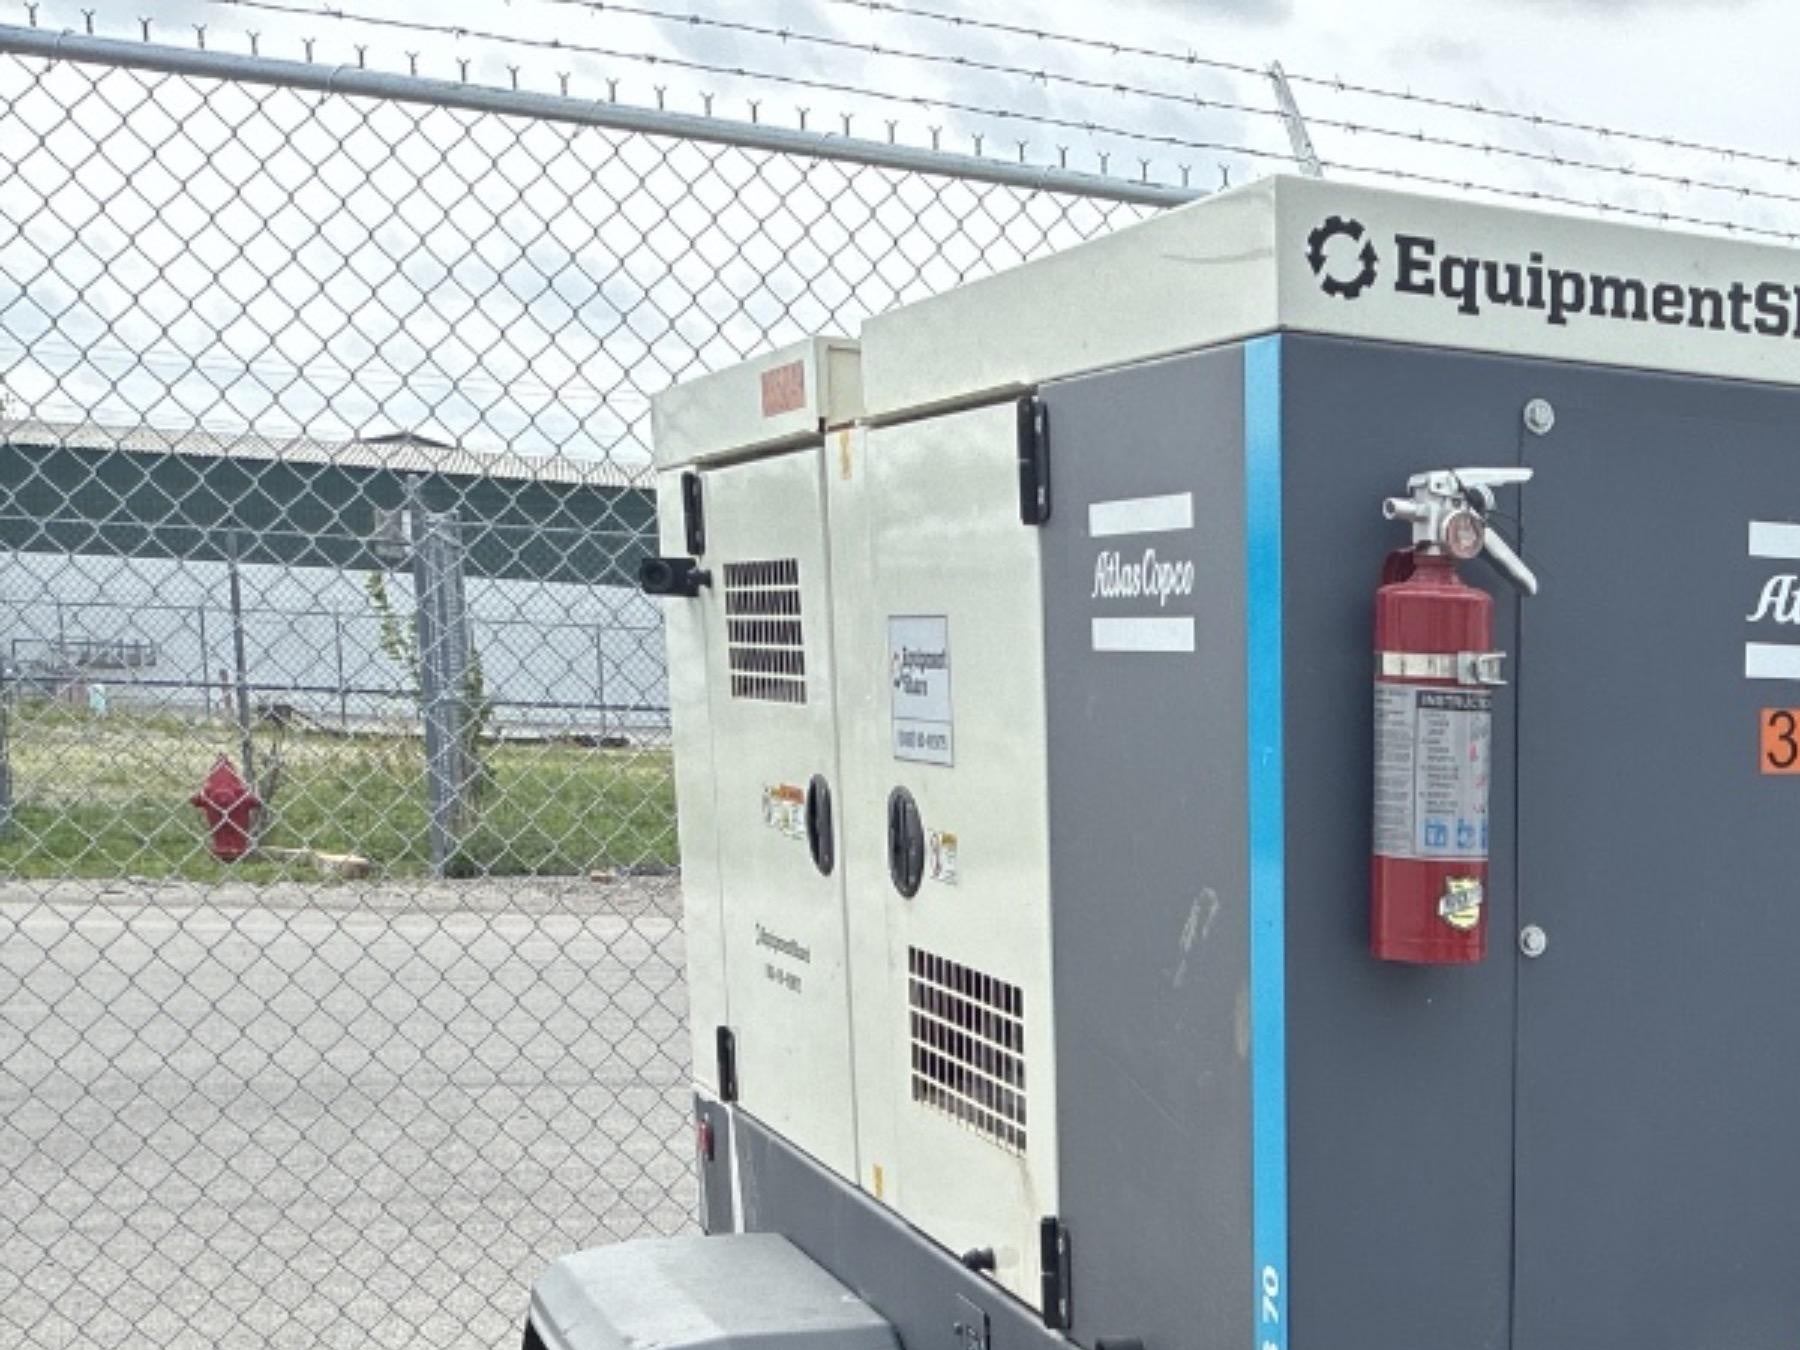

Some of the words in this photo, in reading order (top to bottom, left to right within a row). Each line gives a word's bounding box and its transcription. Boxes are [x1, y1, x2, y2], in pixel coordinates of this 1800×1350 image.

[1091, 550, 1141, 598] Atlas
[1142, 548, 1194, 607] Copco
[1262, 1265, 1280, 1324] 70
